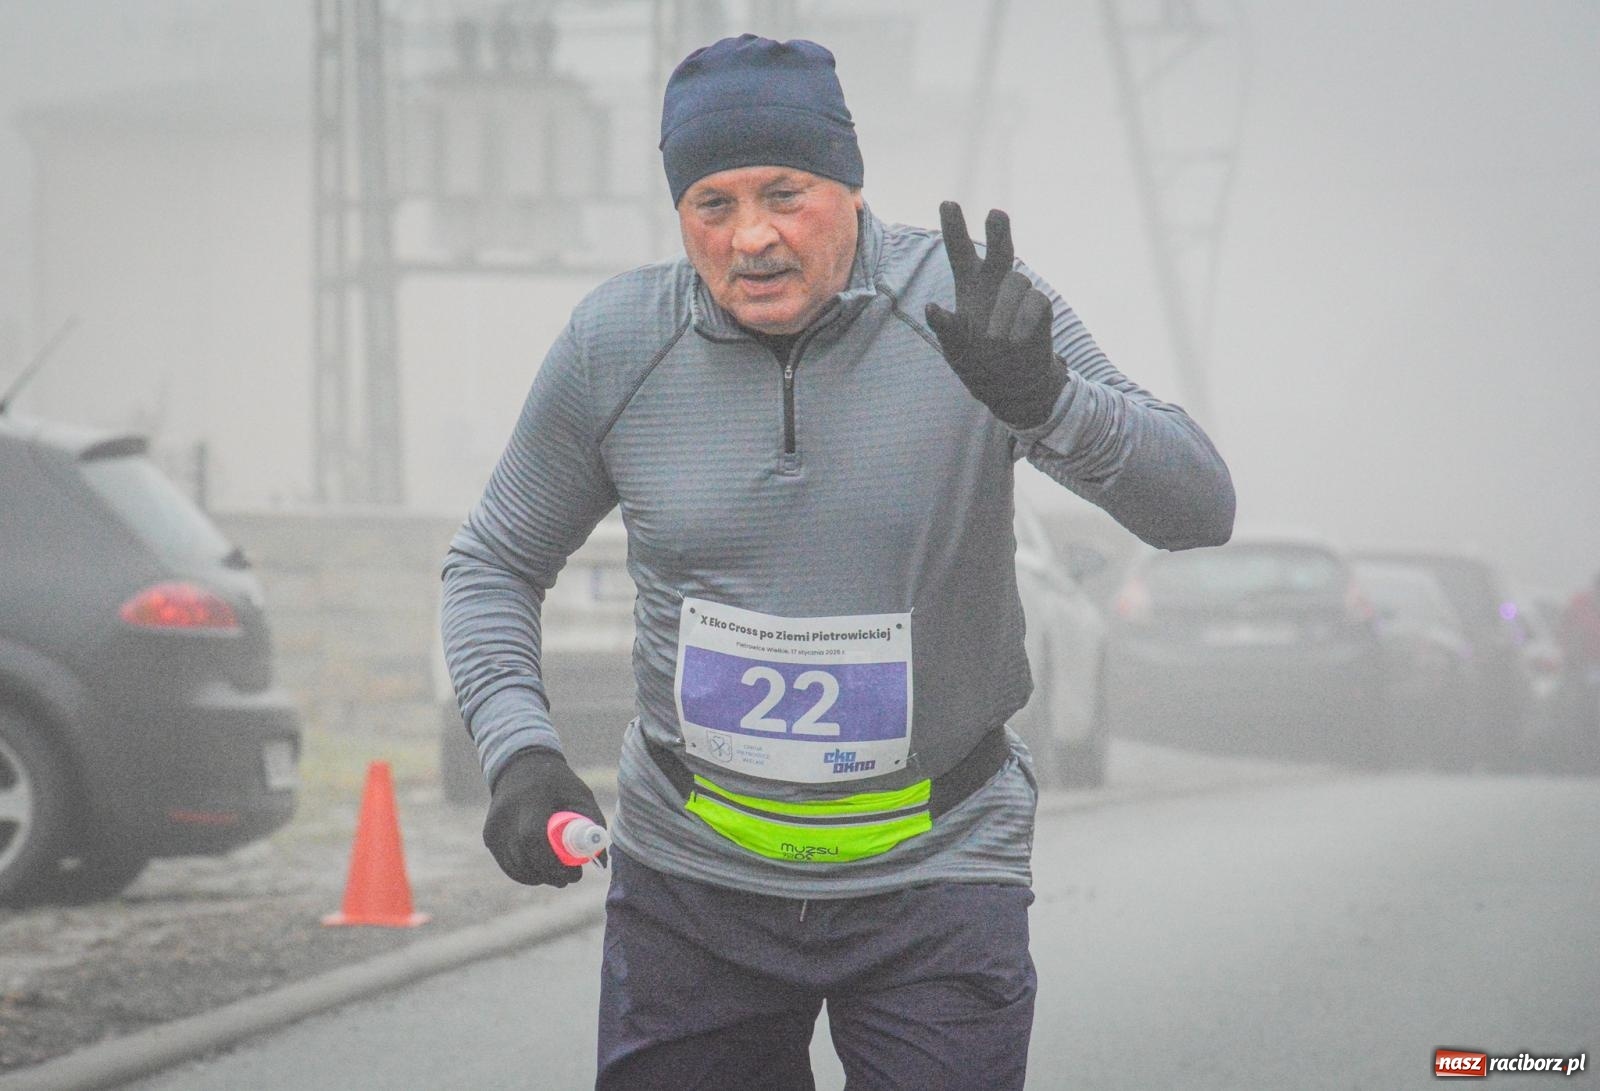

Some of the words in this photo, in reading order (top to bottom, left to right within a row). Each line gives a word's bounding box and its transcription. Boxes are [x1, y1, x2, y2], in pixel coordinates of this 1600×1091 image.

[700, 615, 708, 625] X
[709, 617, 727, 629] Eko
[728, 622, 758, 636] Cross
[759, 630, 774, 640] po
[775, 631, 810, 642] Ziemi
[811, 628, 892, 642] Pietrowickiej
[740, 666, 841, 736] 22
